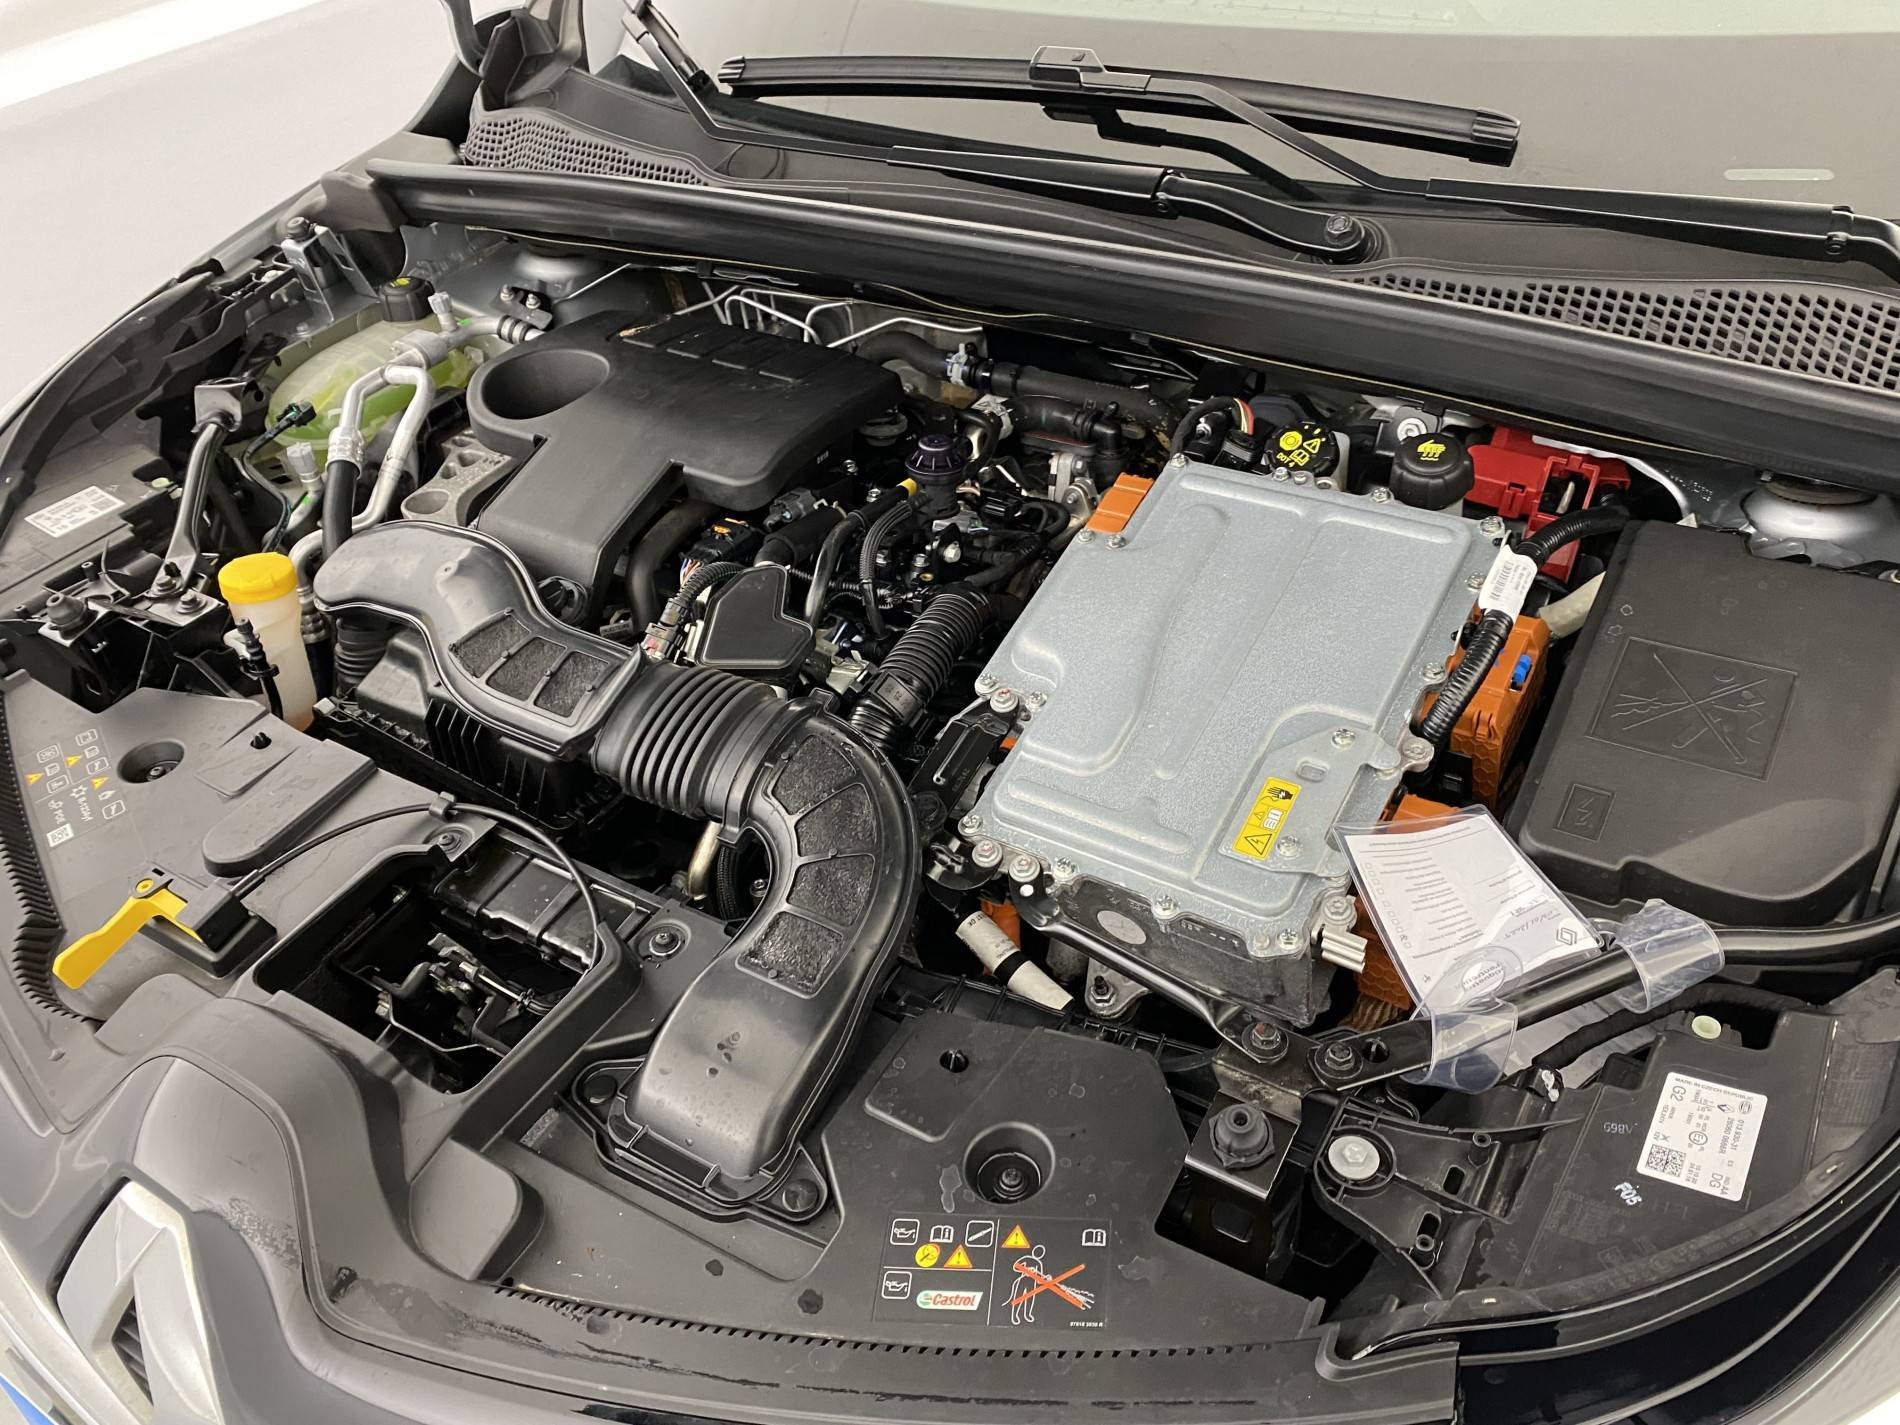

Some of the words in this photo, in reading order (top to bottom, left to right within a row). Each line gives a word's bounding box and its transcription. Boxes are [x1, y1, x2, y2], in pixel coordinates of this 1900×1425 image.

[1276, 452, 1291, 462] DOT
[1669, 1084, 1686, 1103] G2
[1708, 1172, 1723, 1189] DG
[932, 1293, 976, 1307] Castrol
